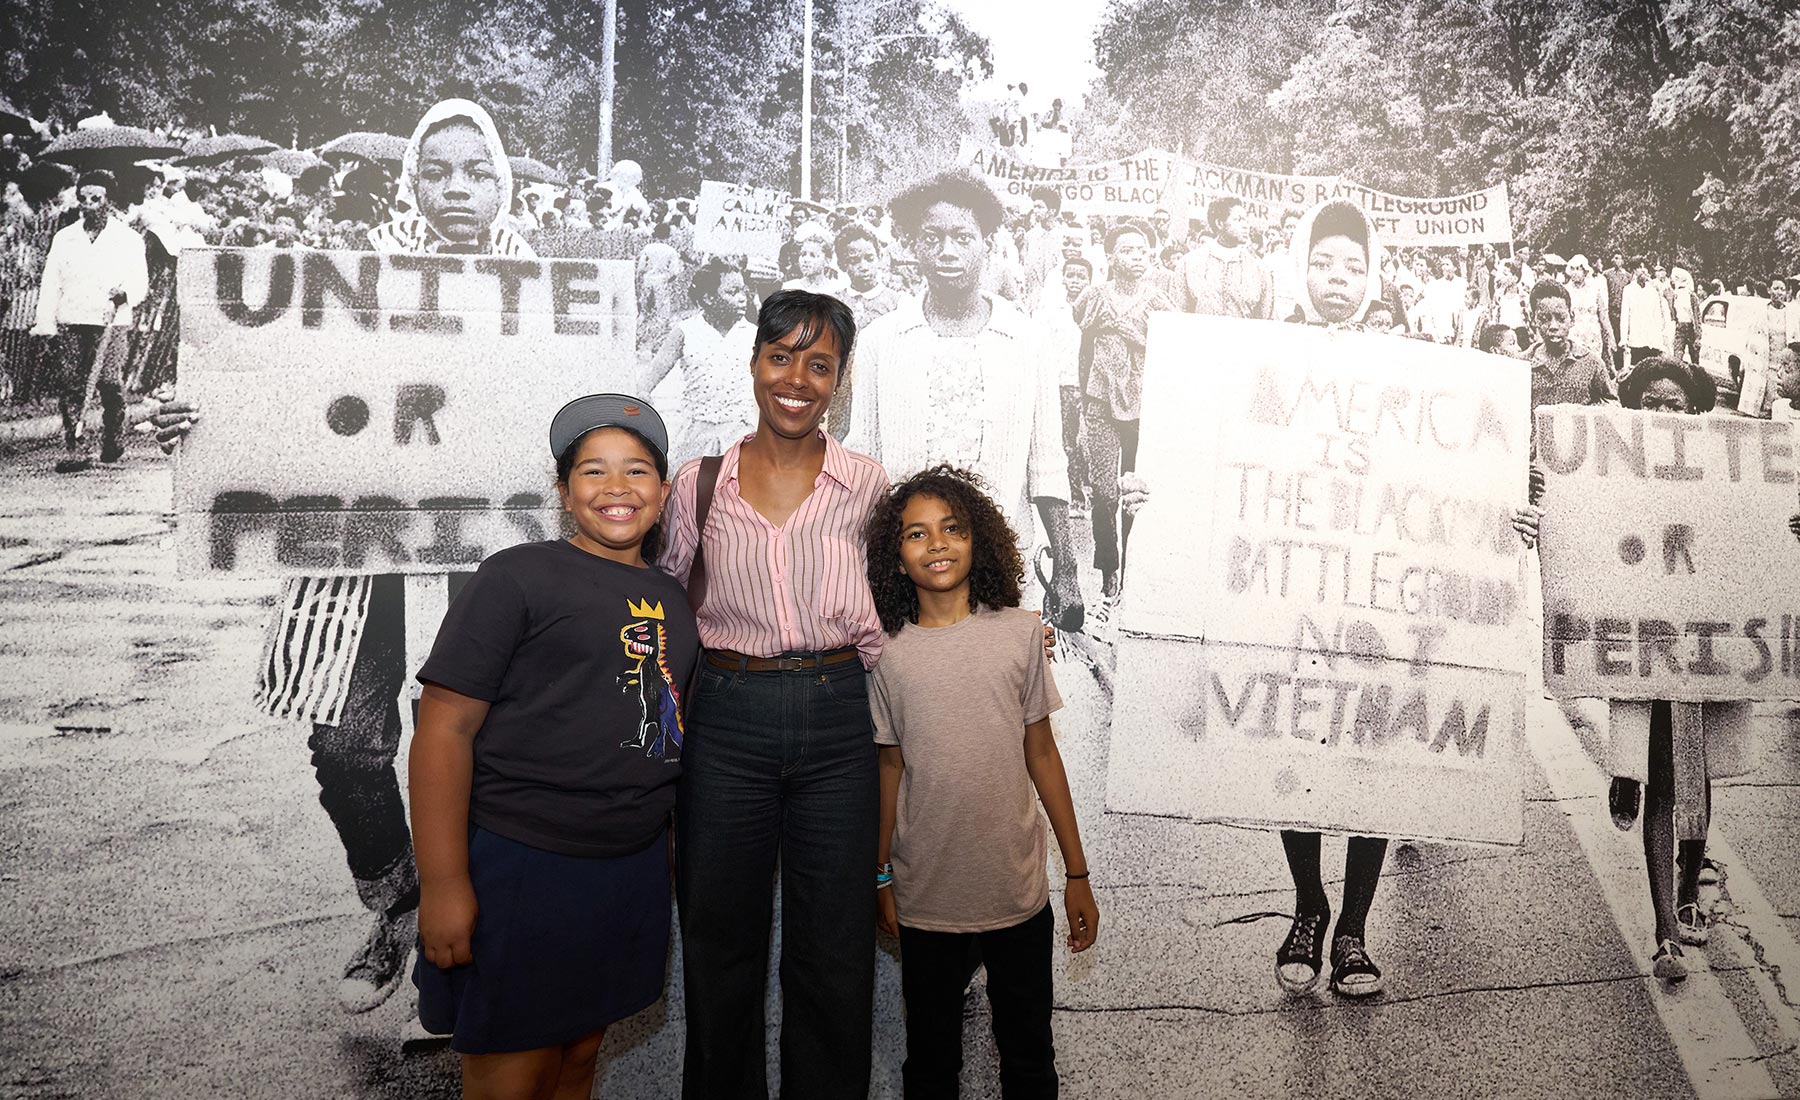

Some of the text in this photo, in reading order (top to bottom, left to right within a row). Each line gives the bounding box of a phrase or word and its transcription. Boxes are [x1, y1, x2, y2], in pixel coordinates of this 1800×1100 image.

[1119, 157, 1159, 182] THE
[1186, 165, 1306, 204] ACKMAN'S
[1243, 200, 1269, 221] AR
[1416, 217, 1485, 235] UNION
[214, 252, 601, 336] UNITE
[325, 382, 446, 446] OR
[1247, 365, 1513, 454] AMERICA
[1313, 432, 1373, 477] IS
[1538, 413, 1796, 484] UNITE
[209, 489, 577, 571] PERIS
[1225, 461, 1318, 532] THE
[1617, 523, 1697, 576] OR
[1209, 671, 1491, 759] VIETNAM
